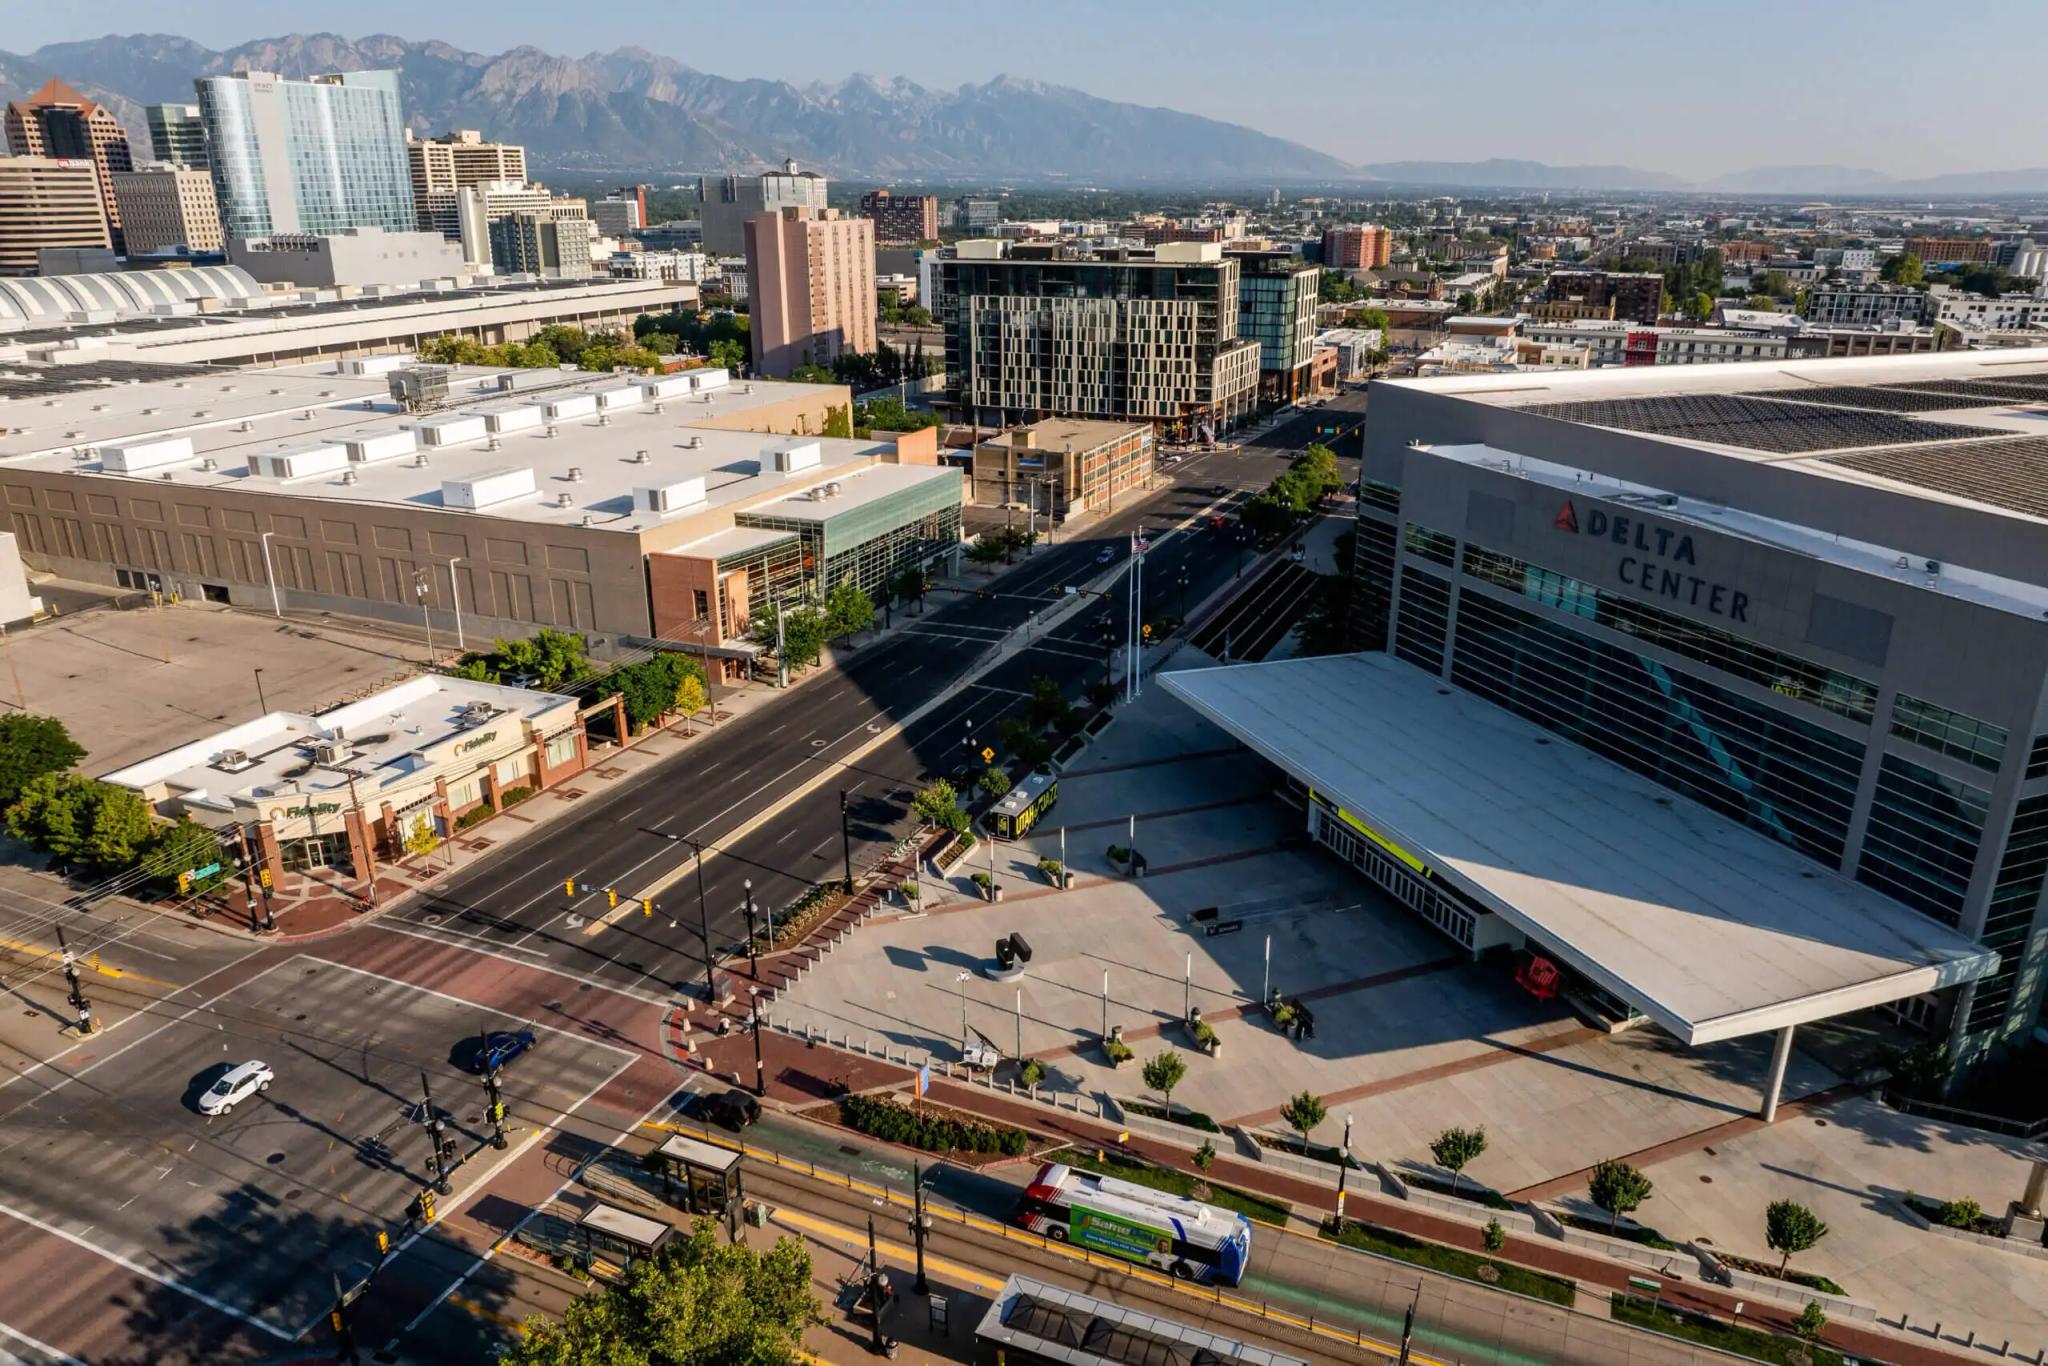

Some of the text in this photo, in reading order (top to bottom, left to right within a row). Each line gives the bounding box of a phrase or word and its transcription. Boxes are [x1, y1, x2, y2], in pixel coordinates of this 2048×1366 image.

[1588, 510, 1696, 565] DELTA
[1619, 557, 1749, 623] CENTER
[465, 731, 498, 752] Fidelity
[287, 803, 341, 818] Fidelity
[1016, 805, 1034, 835] UTAH
